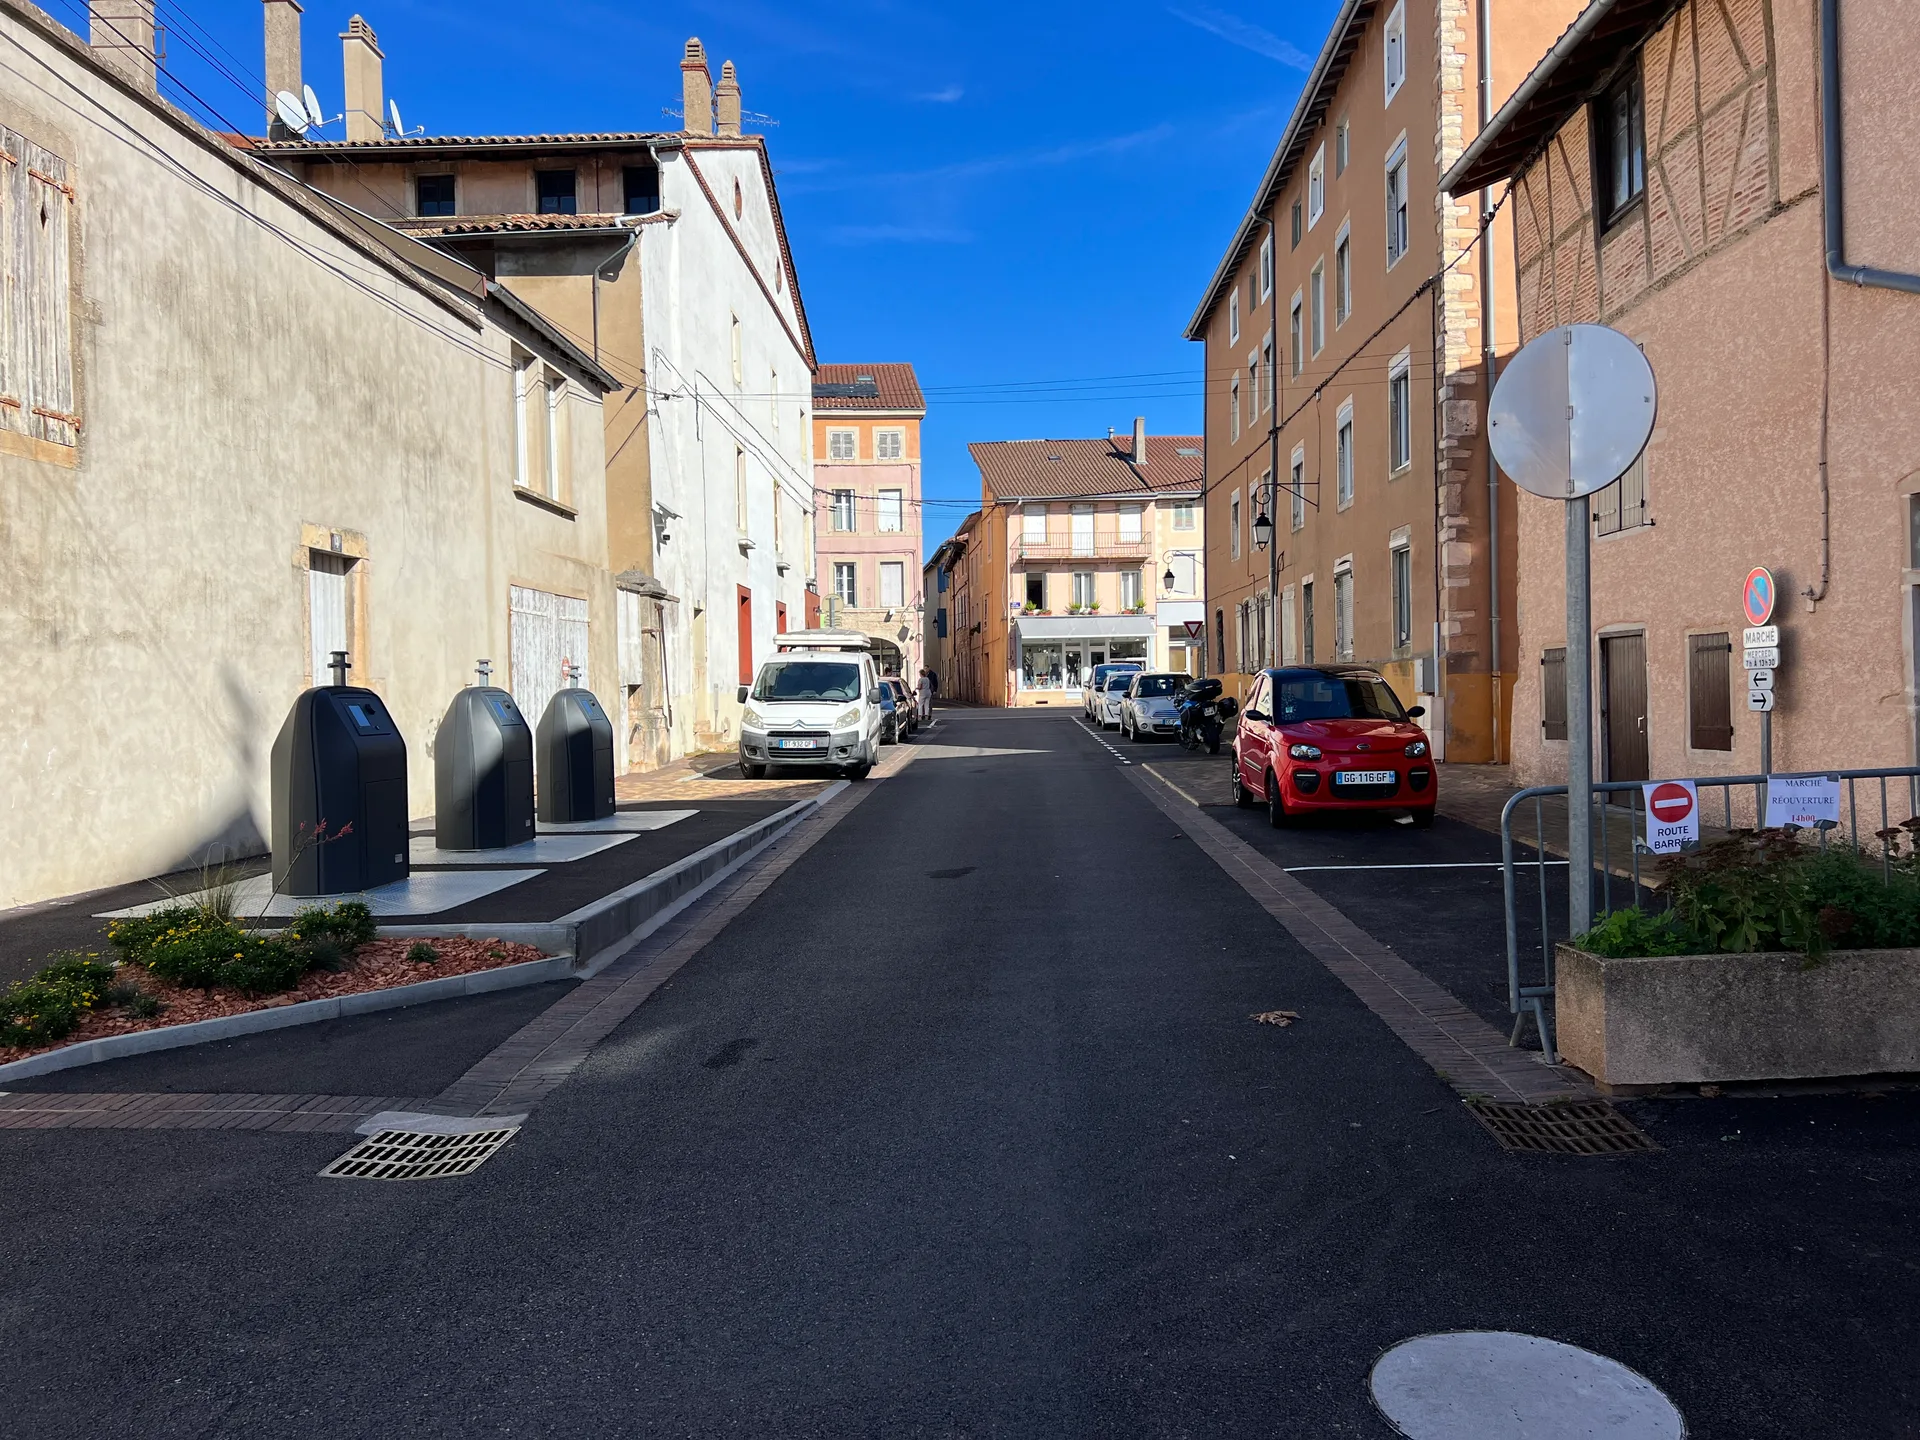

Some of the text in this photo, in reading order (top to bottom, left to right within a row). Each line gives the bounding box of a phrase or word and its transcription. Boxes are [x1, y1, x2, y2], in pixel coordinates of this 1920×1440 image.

[1746, 628, 1775, 643] MARCHÉ
[1747, 649, 1774, 658] MERCREDI
[1772, 795, 1835, 804] RÉOUVERTURE
[1791, 814, 1816, 822] 14h00
[1657, 825, 1689, 837] ROUTE
